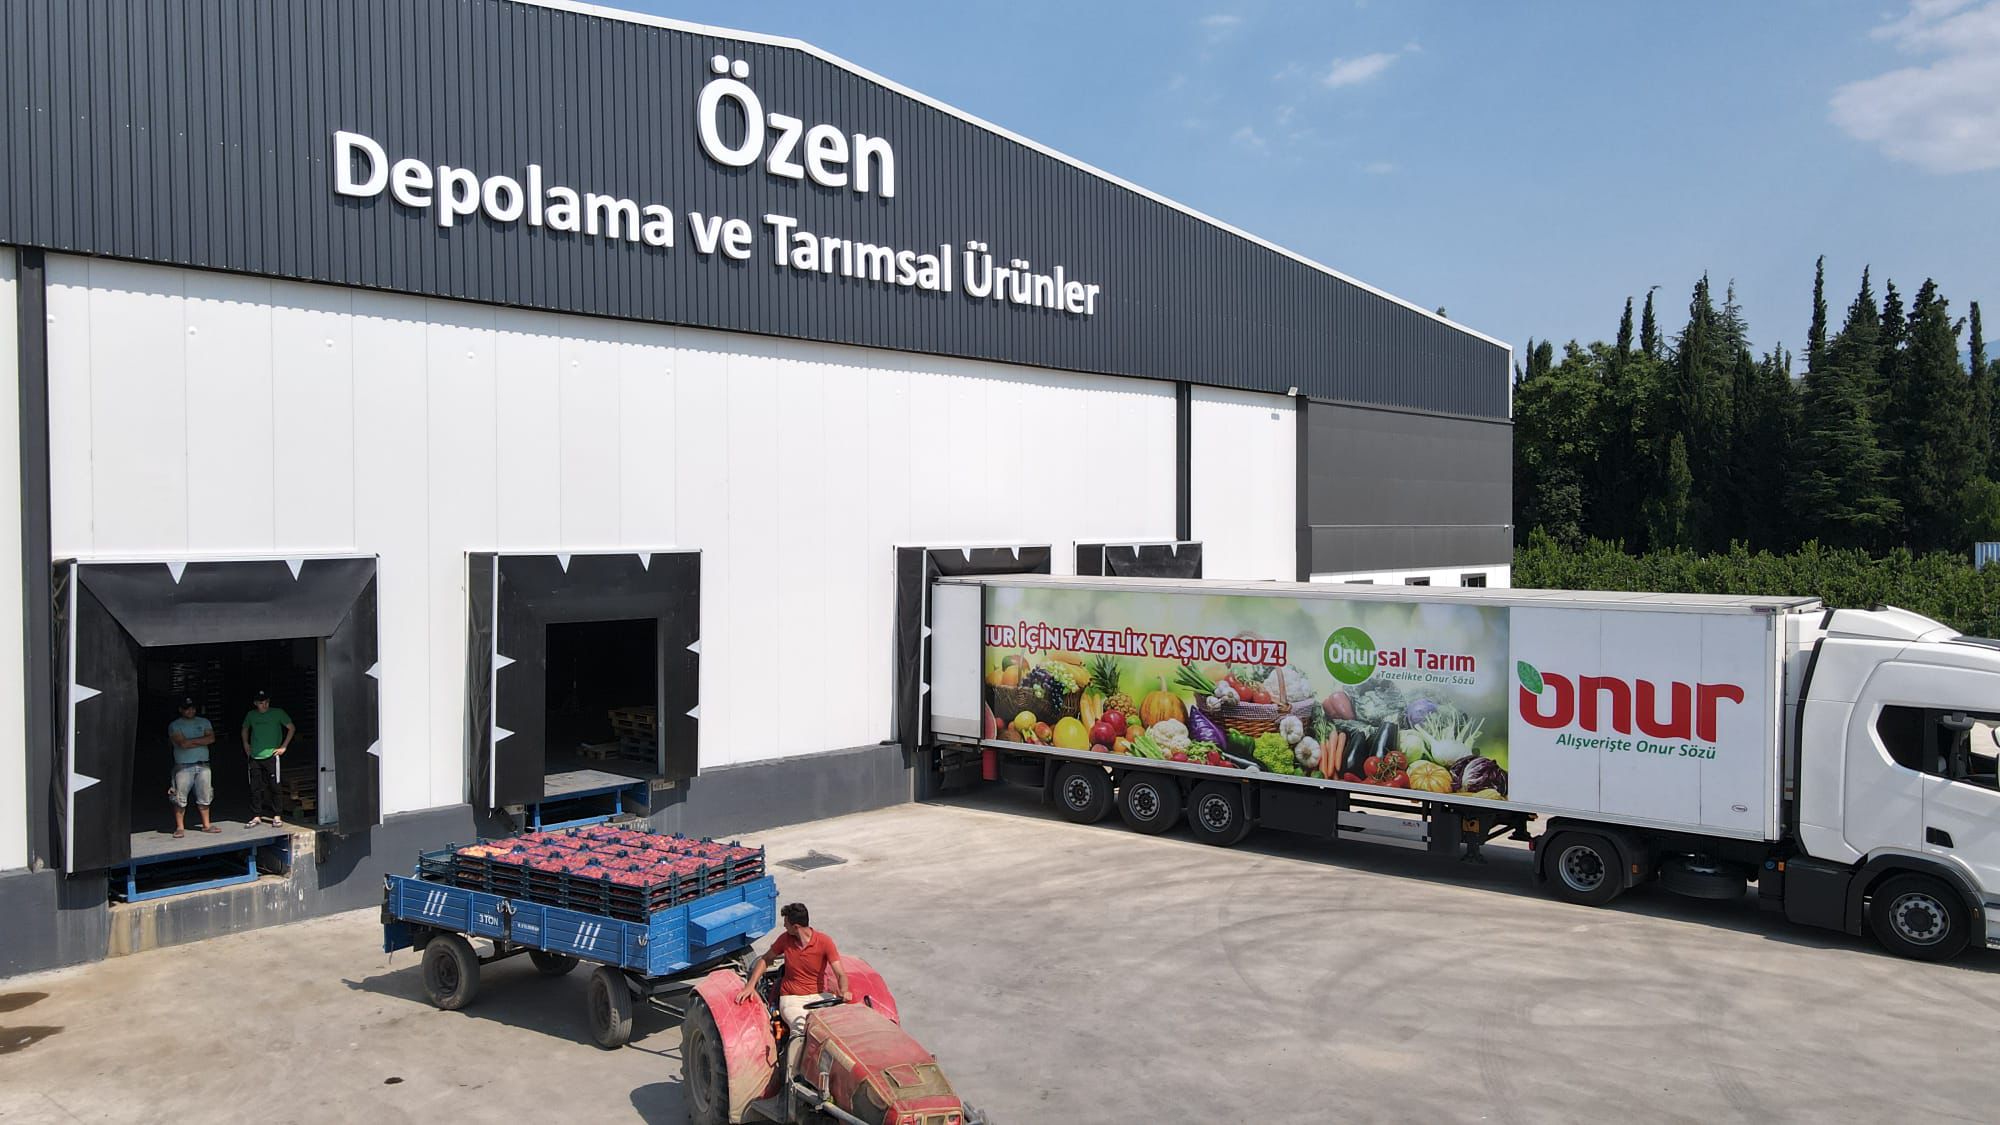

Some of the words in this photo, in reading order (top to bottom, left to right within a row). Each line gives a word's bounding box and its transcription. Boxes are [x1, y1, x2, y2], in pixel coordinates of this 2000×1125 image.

[696, 54, 896, 198] Özen
[333, 129, 674, 248] Depolama
[689, 211, 753, 260] ve
[763, 212, 952, 294] Tarımsal
[962, 240, 1100, 316] Ürünler
[1019, 621, 1060, 654] İÇİN
[1063, 627, 1147, 656] TAZELİK
[1150, 633, 1287, 666] TAŞIYORUZ!
[1414, 648, 1475, 672] Tarım
[1379, 670, 1422, 682] Tazelikte
[1425, 673, 1449, 684] Onur
[1452, 676, 1475, 685] Sözü
[1556, 733, 1632, 752] Alışverişte
[1636, 740, 1675, 755] Onur
[1679, 744, 1716, 759] Sözü
[484, 914, 498, 926] TON
